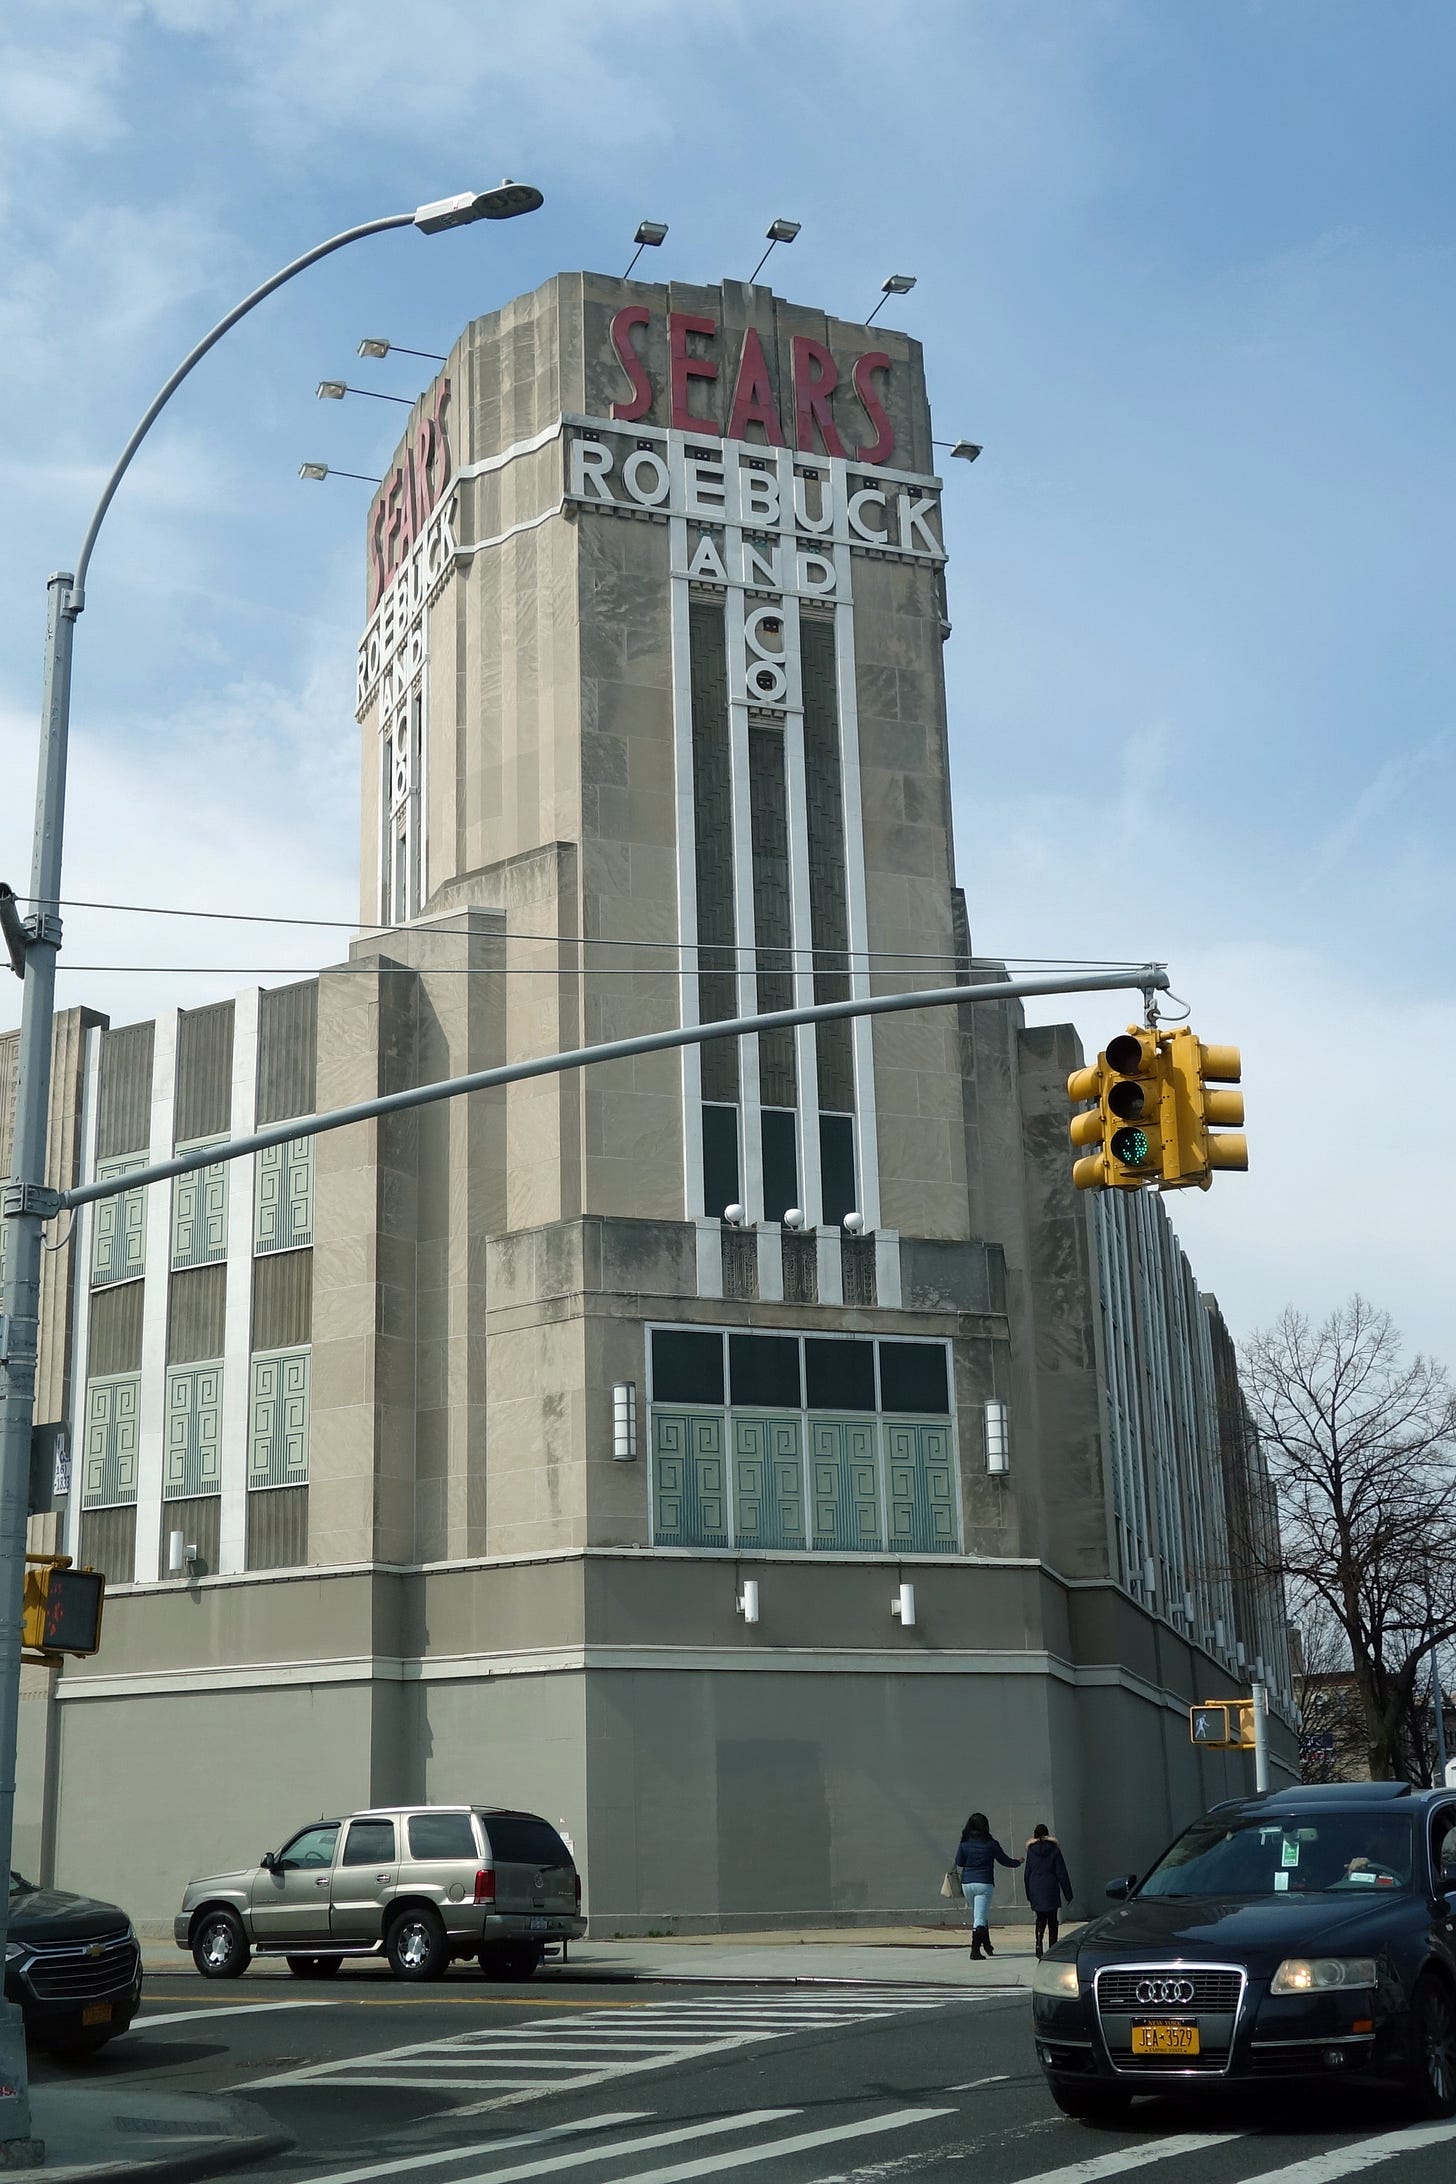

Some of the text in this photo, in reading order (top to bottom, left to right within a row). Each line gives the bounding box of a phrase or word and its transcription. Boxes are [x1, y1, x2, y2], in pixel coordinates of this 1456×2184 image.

[610, 305, 895, 464] SEARS
[369, 378, 451, 618] SEARS
[569, 438, 943, 556] ROEBUCK
[688, 535, 837, 595] AND
[744, 606, 788, 701] CO
